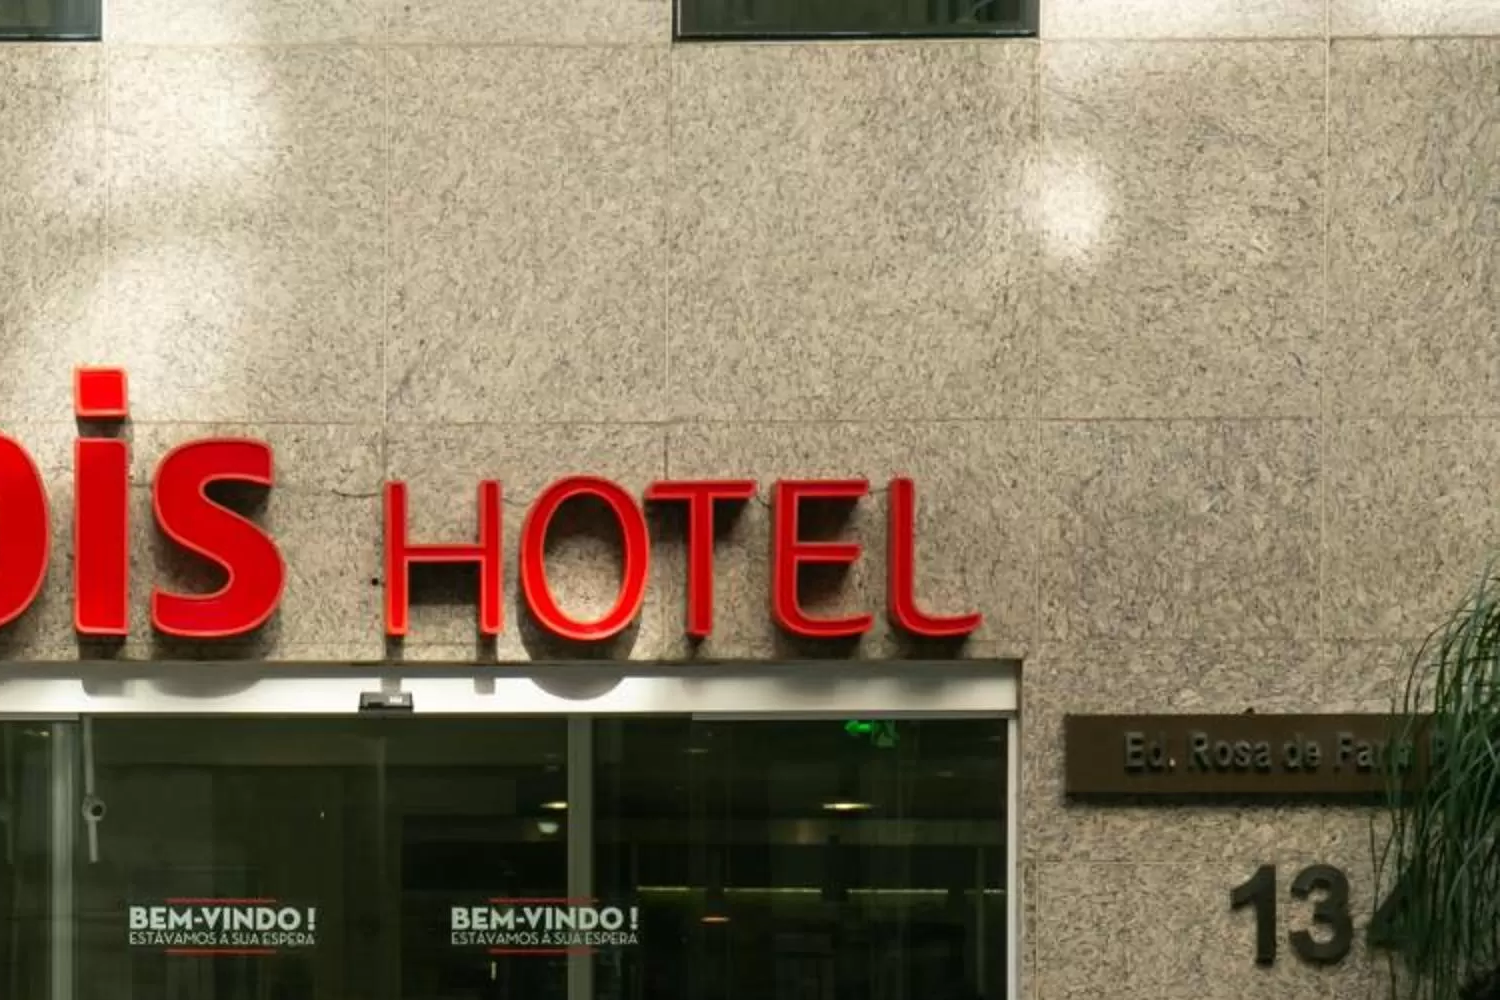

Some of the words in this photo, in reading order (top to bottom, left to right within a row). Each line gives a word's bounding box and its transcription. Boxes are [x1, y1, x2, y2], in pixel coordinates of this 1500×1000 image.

[382, 474, 984, 642] HOTEL
[1124, 730, 1177, 768] Ed.
[1185, 729, 1271, 768] Rosa
[1282, 731, 1322, 768] de
[231, 931, 260, 945] SUA
[261, 931, 316, 945] ESPERA
[553, 931, 583, 945] SUA
[585, 931, 639, 945] ESPERA
